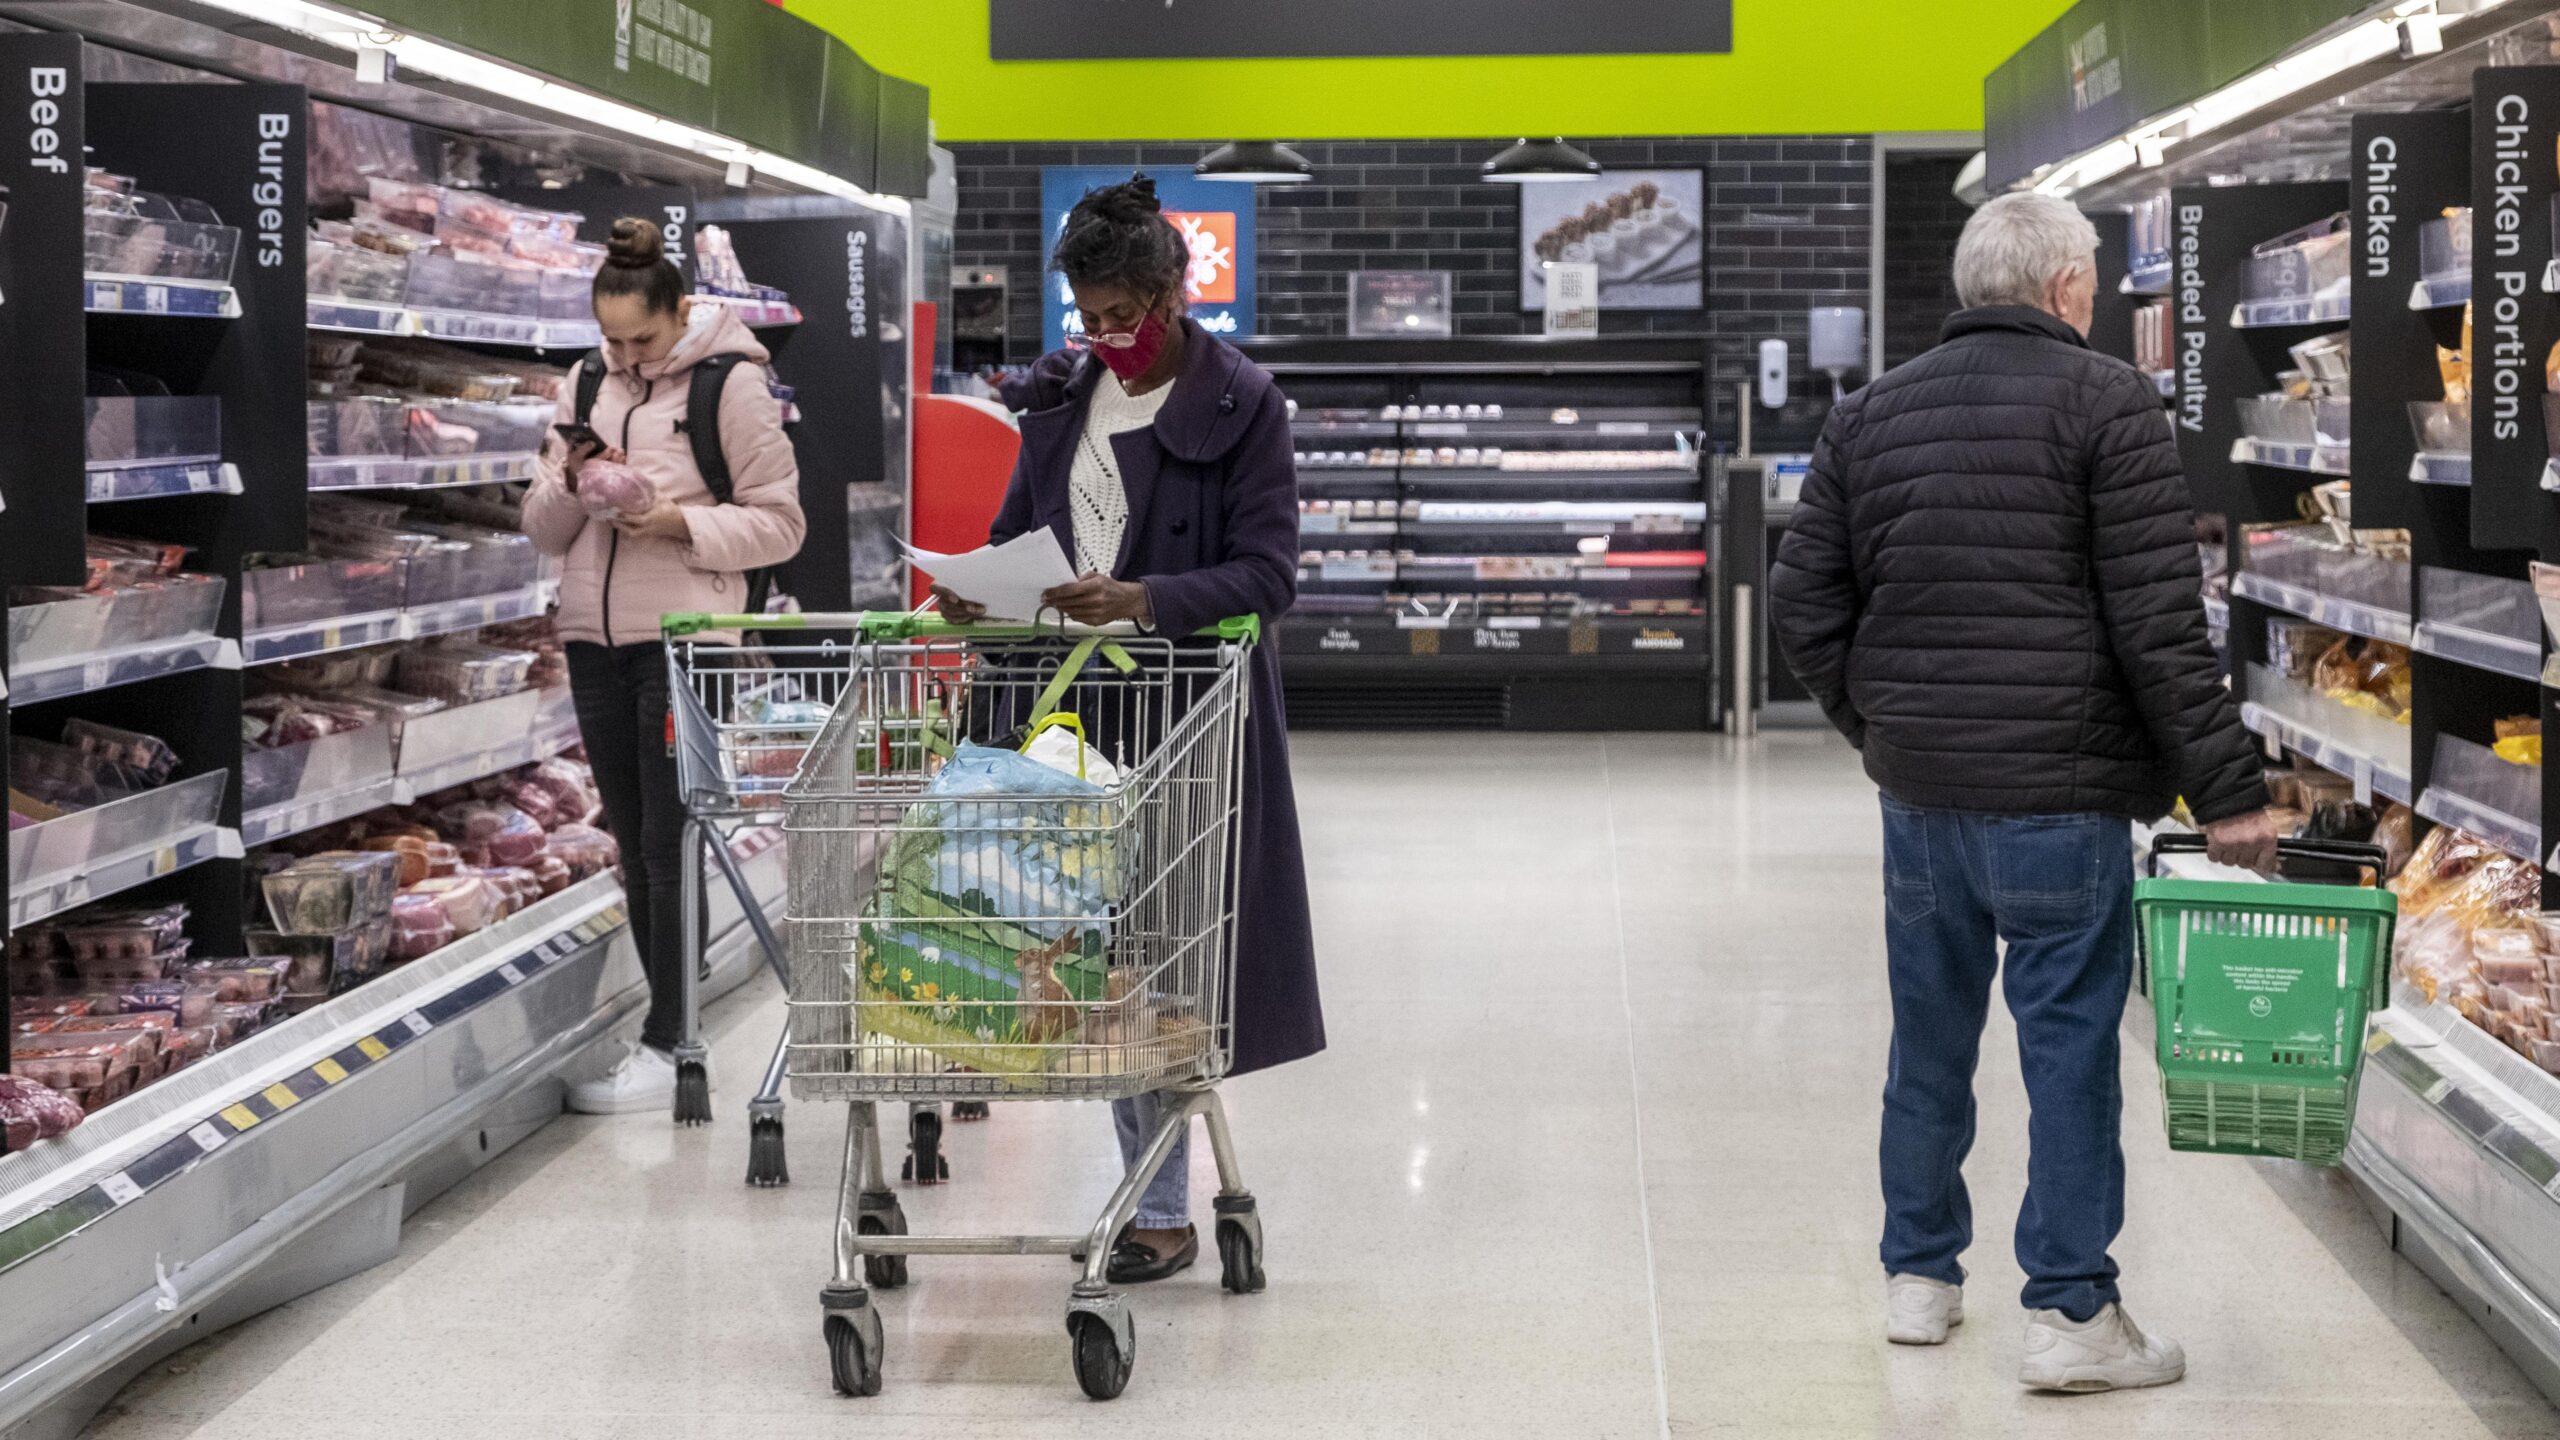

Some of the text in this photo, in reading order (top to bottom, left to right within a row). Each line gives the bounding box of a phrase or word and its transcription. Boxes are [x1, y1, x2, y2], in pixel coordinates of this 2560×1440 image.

[29, 67, 69, 174] Beef
[252, 113, 290, 267] Burgers
[2367, 136, 2398, 277] Chicken
[2494, 94, 2529, 440] Chicken Portions
[846, 230, 868, 338] Sausages
[2178, 204, 2208, 433] Breaded Poultry
